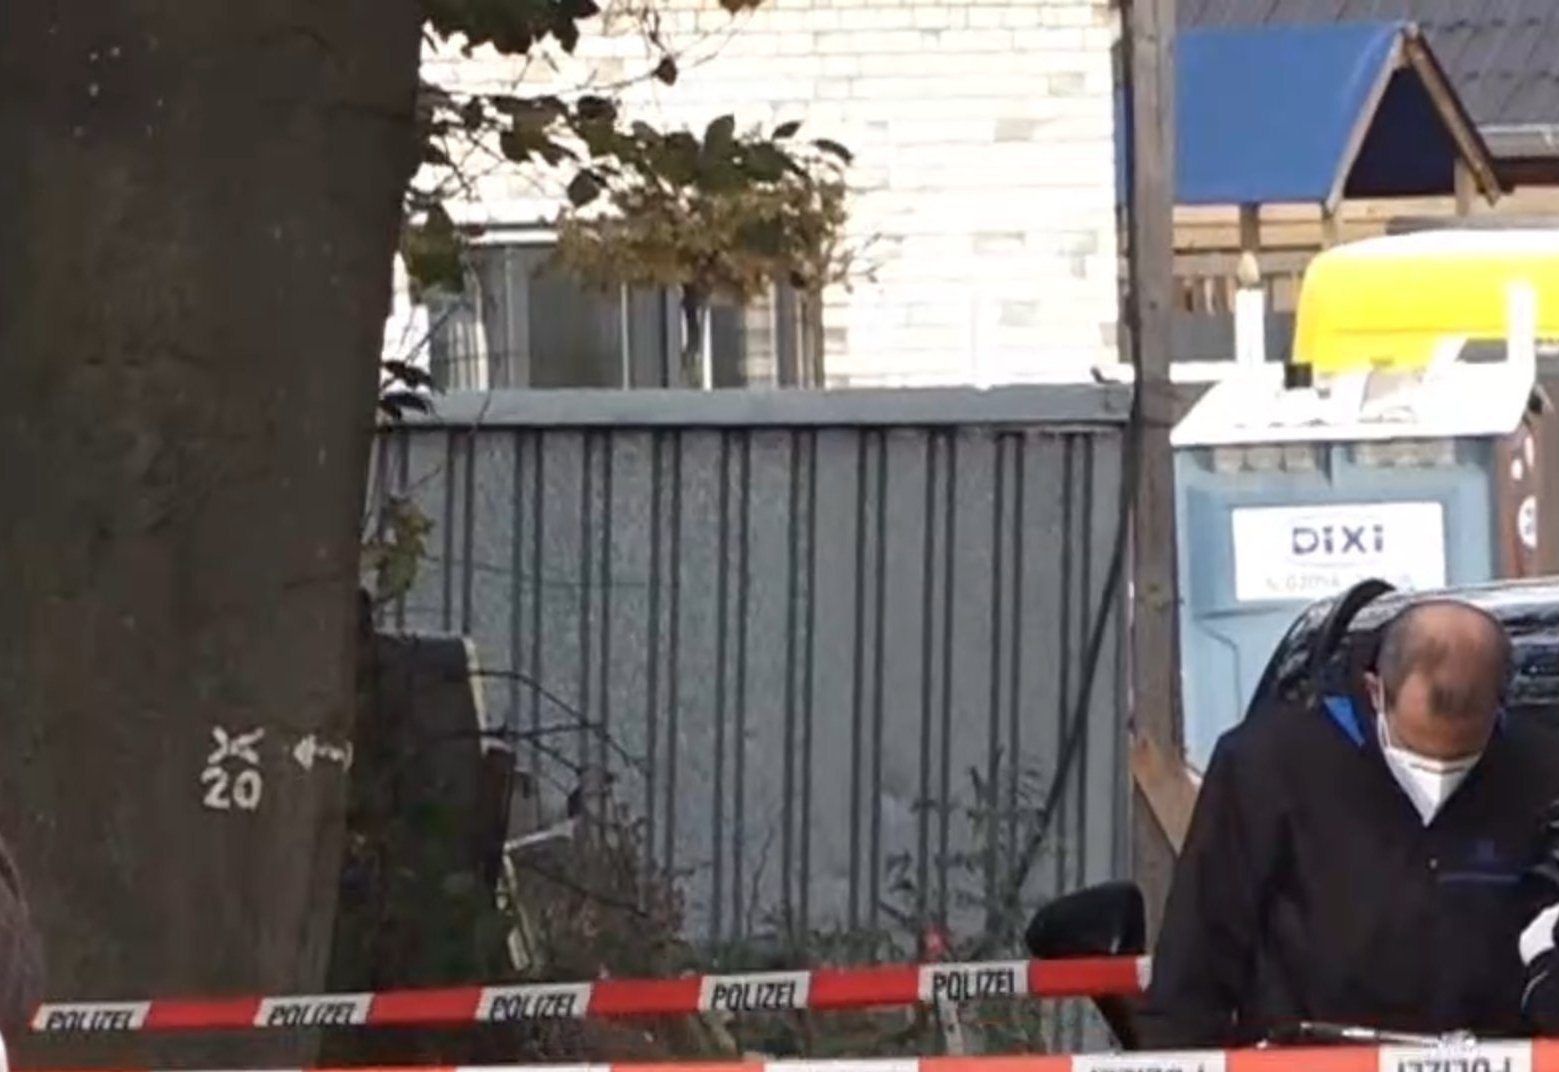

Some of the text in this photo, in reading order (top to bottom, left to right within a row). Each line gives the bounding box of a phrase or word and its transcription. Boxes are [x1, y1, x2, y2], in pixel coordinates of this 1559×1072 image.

[201, 766, 263, 811] 20
[710, 982, 796, 1010] POLIZEI
[931, 968, 1015, 1001] POLIZEI
[488, 993, 575, 1020] POLIZEI
